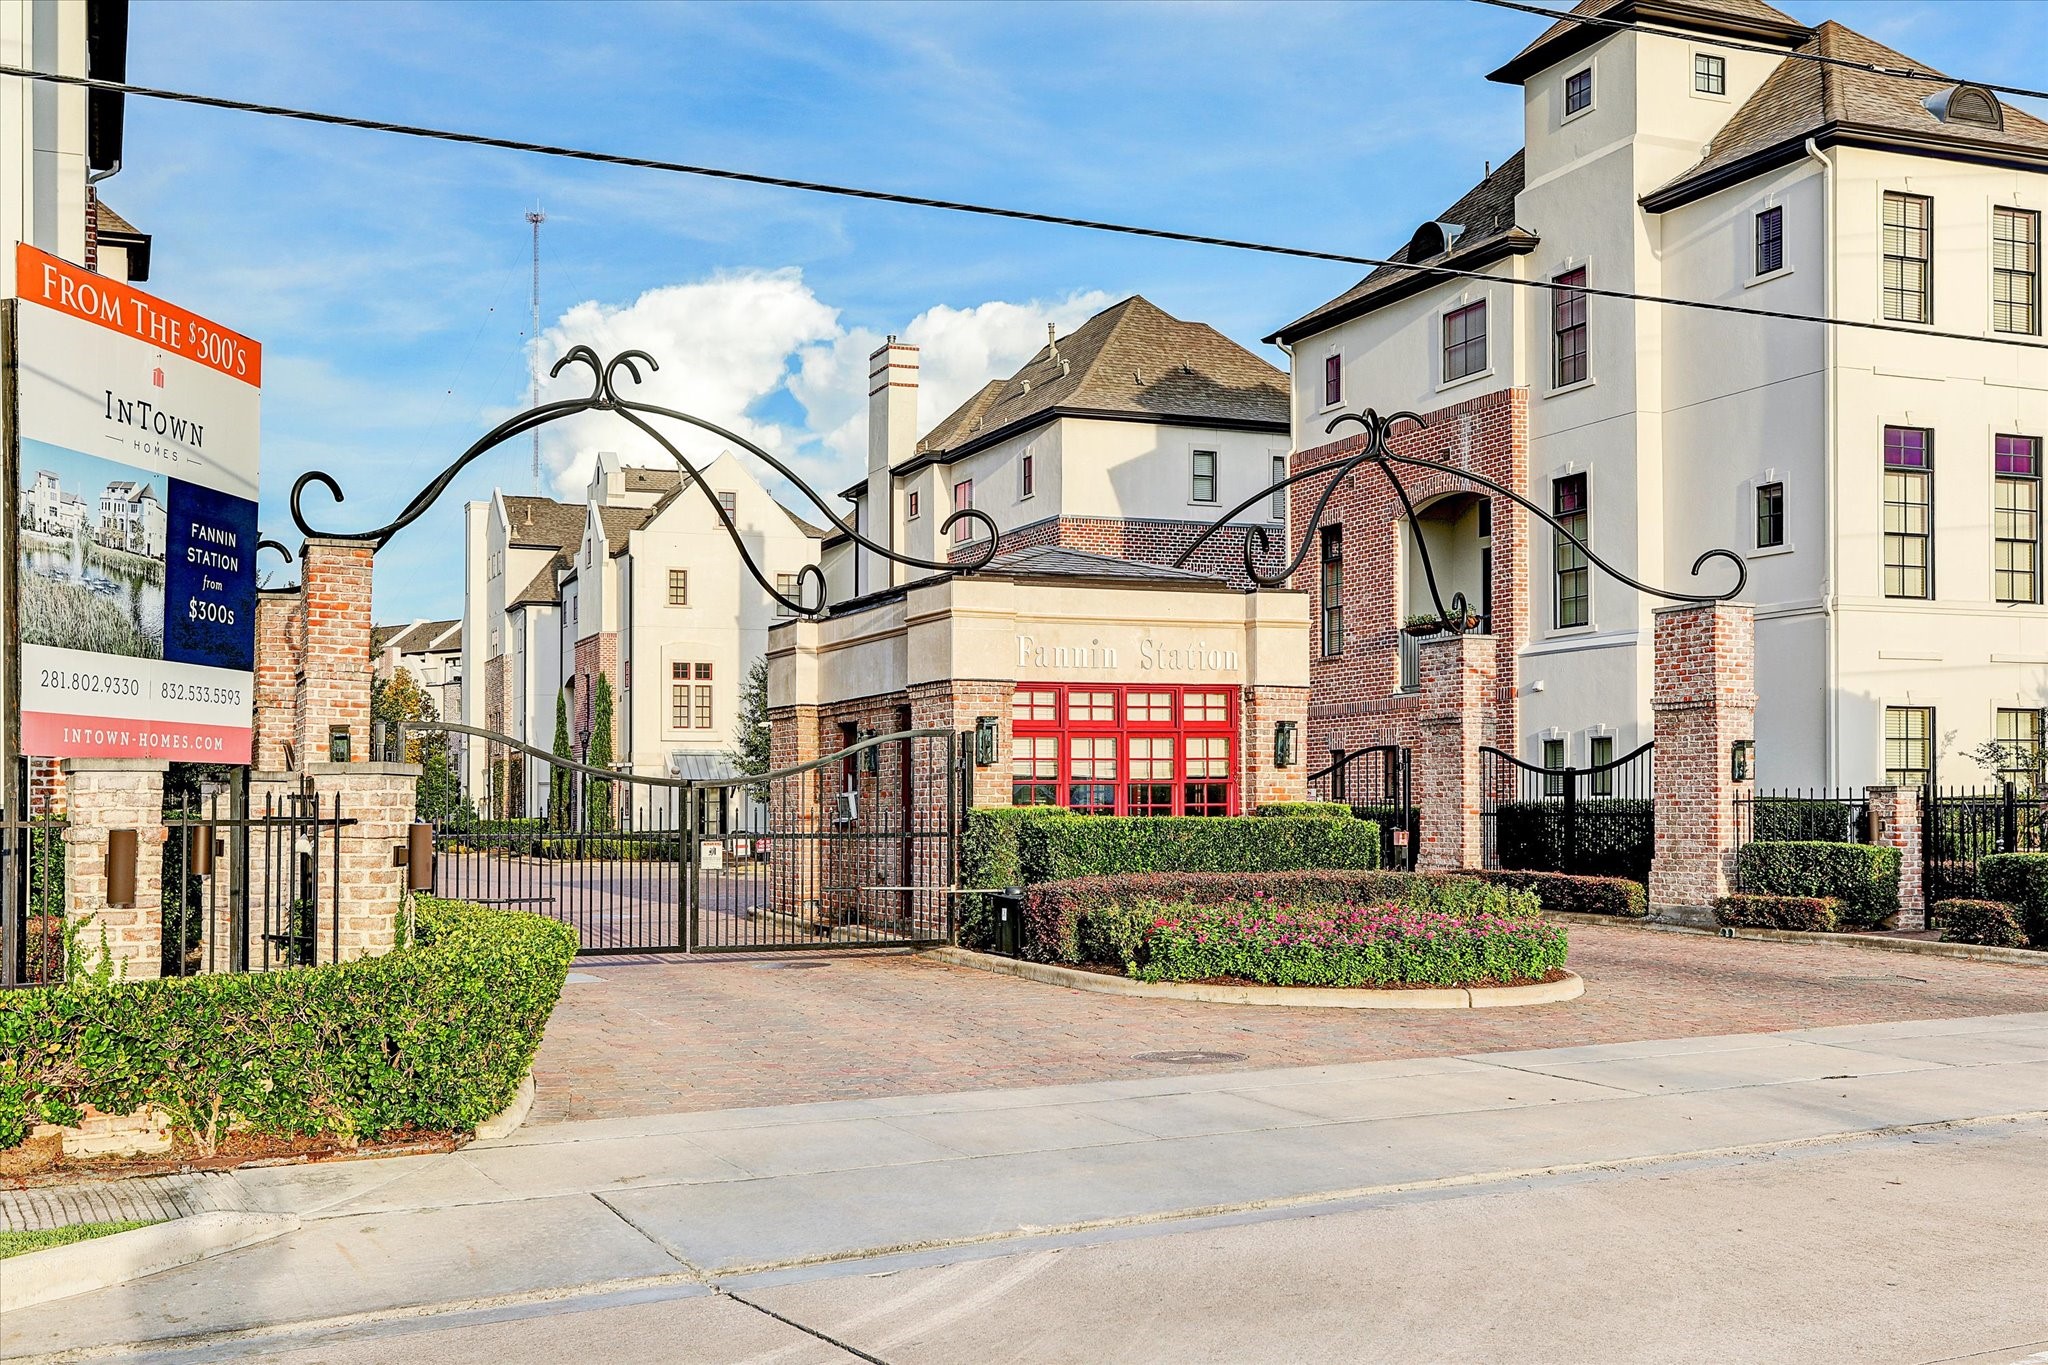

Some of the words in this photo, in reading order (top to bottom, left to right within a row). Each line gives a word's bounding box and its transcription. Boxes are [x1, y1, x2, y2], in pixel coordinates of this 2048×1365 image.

[41, 262, 124, 327] FROM
[130, 298, 182, 349] THE
[188, 320, 247, 376] $300'S
[105, 390, 204, 448] INTOWN
[133, 440, 178, 462] HOMES
[191, 523, 237, 548] FANNIN
[187, 547, 239, 573] STATION
[202, 574, 223, 591] from
[188, 596, 235, 626] $300s
[1016, 635, 1118, 669] Fannin
[1140, 638, 1239, 672] Station
[40, 669, 140, 696] 281.802.9330
[160, 682, 241, 706] 832.533.5593
[63, 727, 224, 751] INTOWN-HOMES.COM
